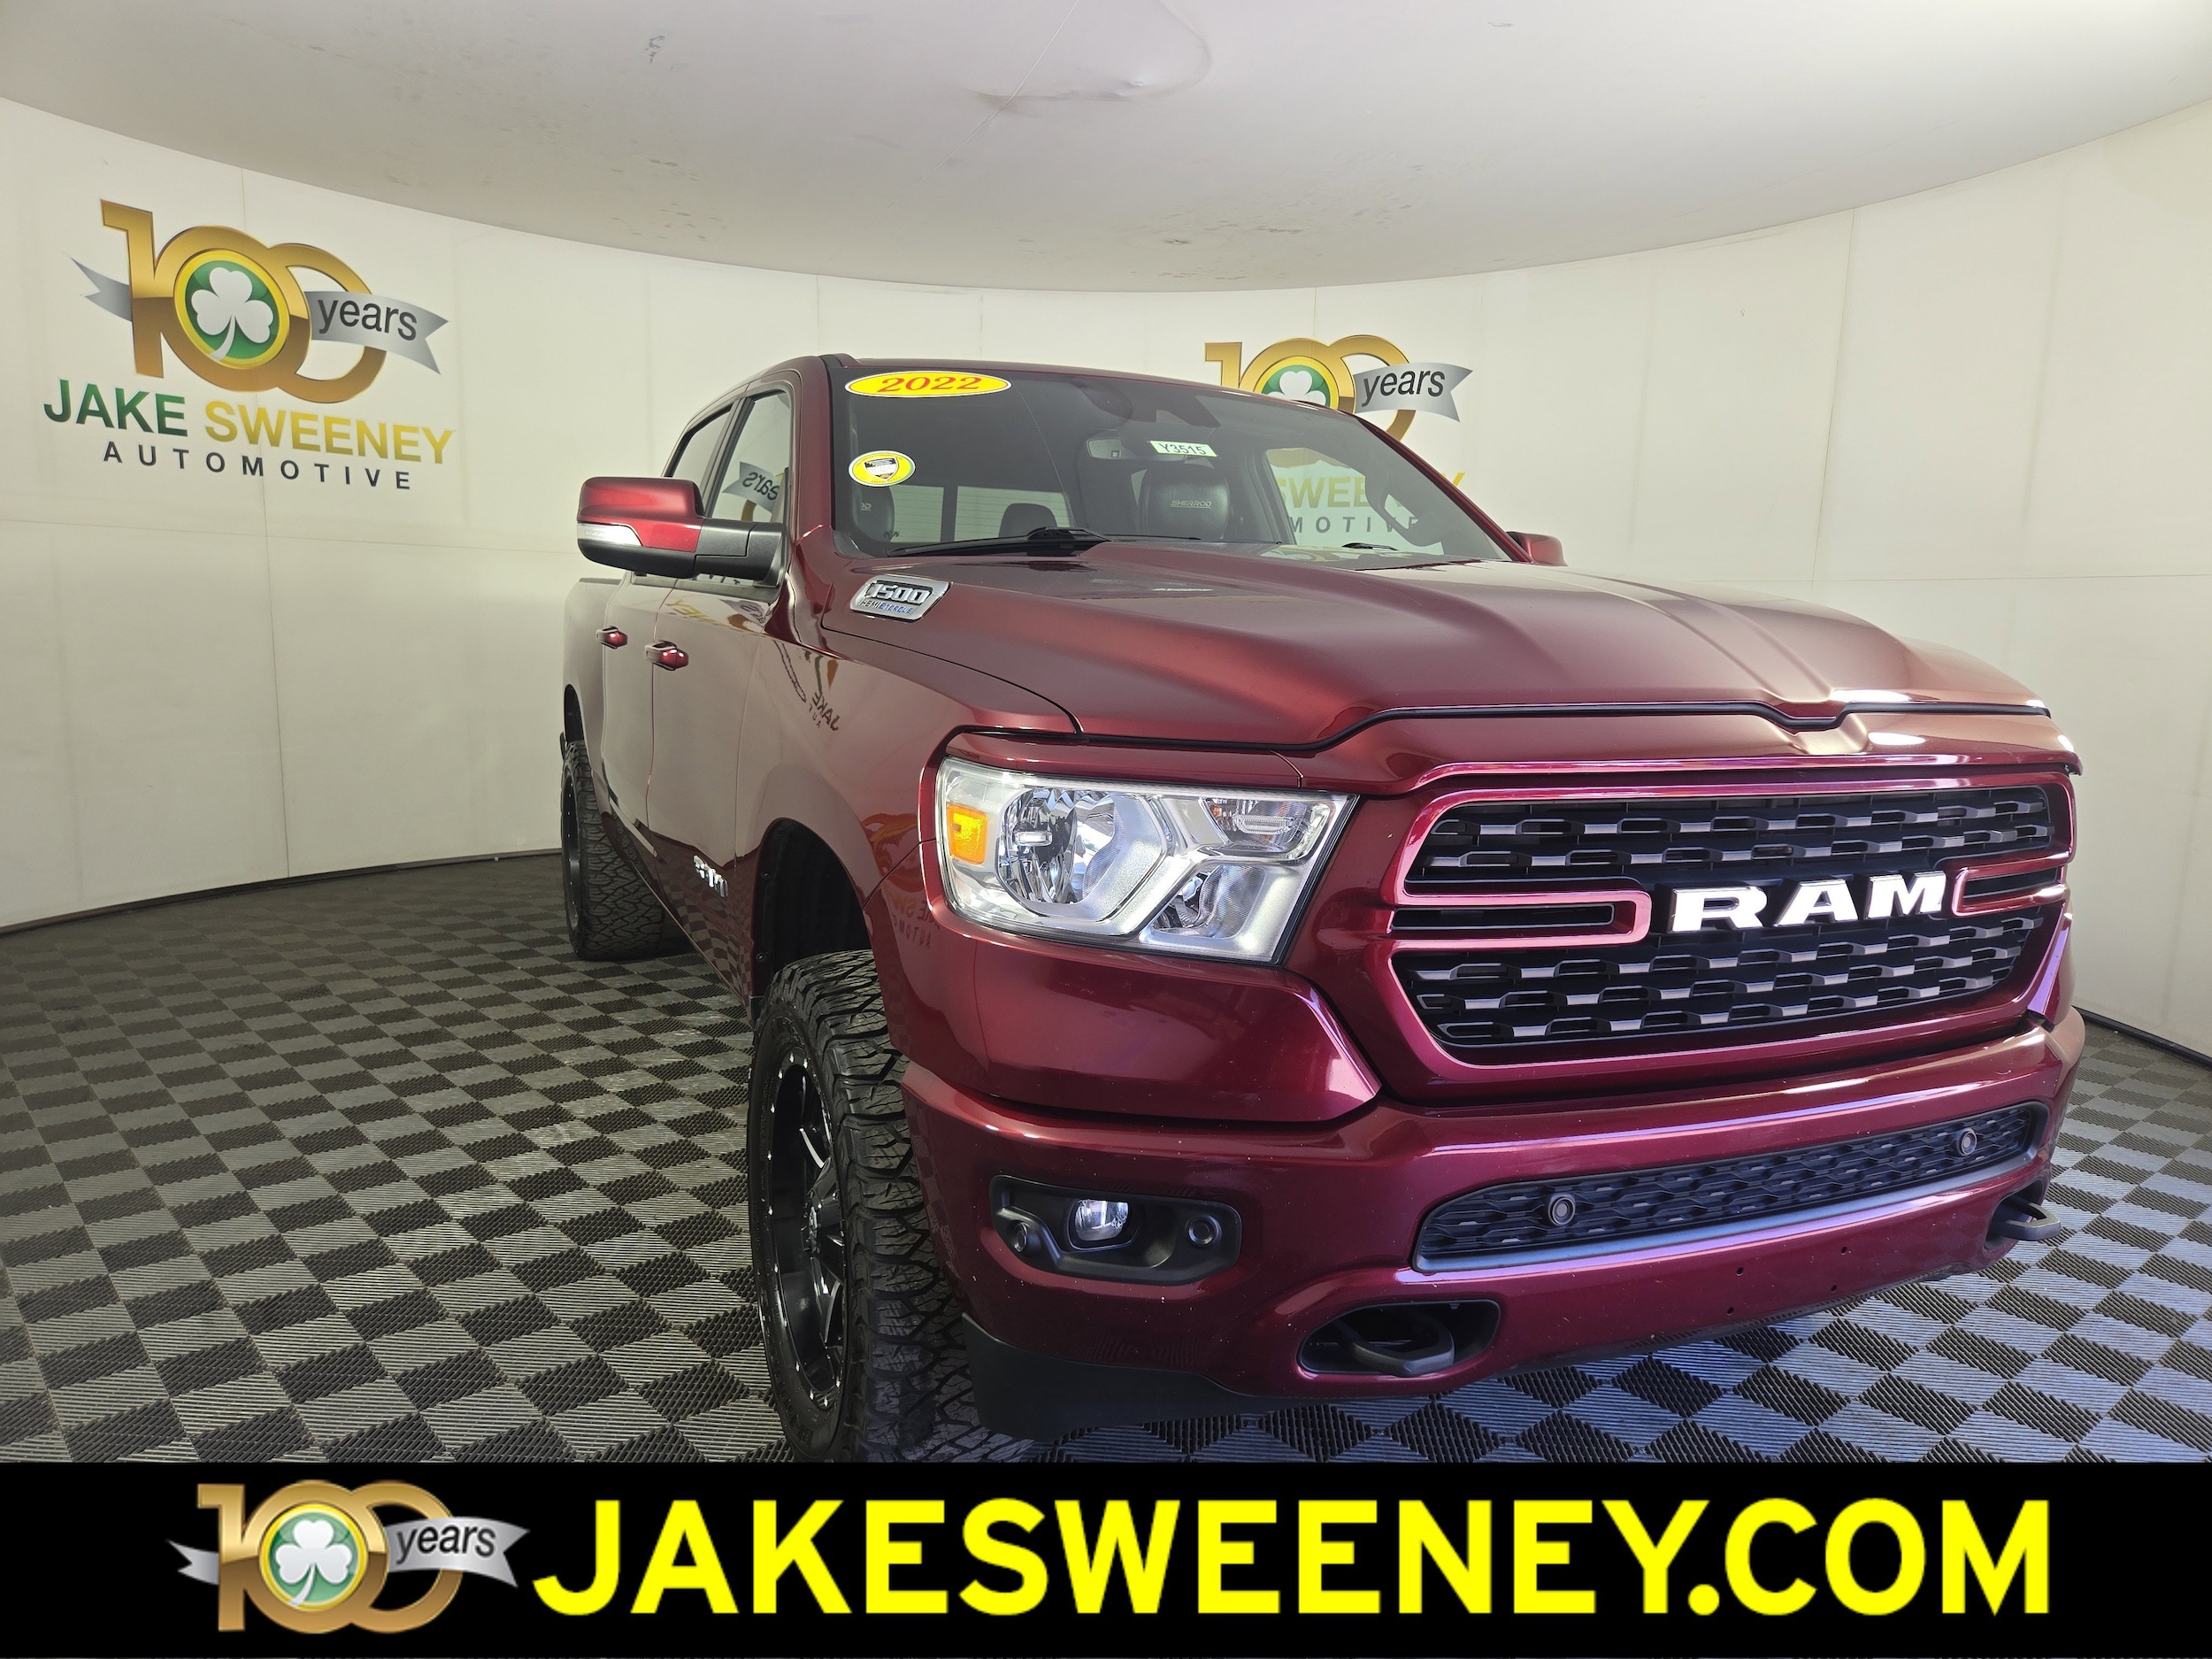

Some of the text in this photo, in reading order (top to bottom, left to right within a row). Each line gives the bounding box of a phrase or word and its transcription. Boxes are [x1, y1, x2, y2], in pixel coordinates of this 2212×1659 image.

[100, 199, 388, 403] 100
[318, 296, 418, 342] years
[877, 376, 982, 393] 2022
[1361, 369, 1446, 408] years
[43, 379, 453, 465] JAKE SWEENEY
[103, 441, 411, 490] AUTOMOTIVE
[1157, 442, 1207, 455] Y3515
[864, 583, 930, 604] 1500
[1671, 871, 1946, 931] RAM
